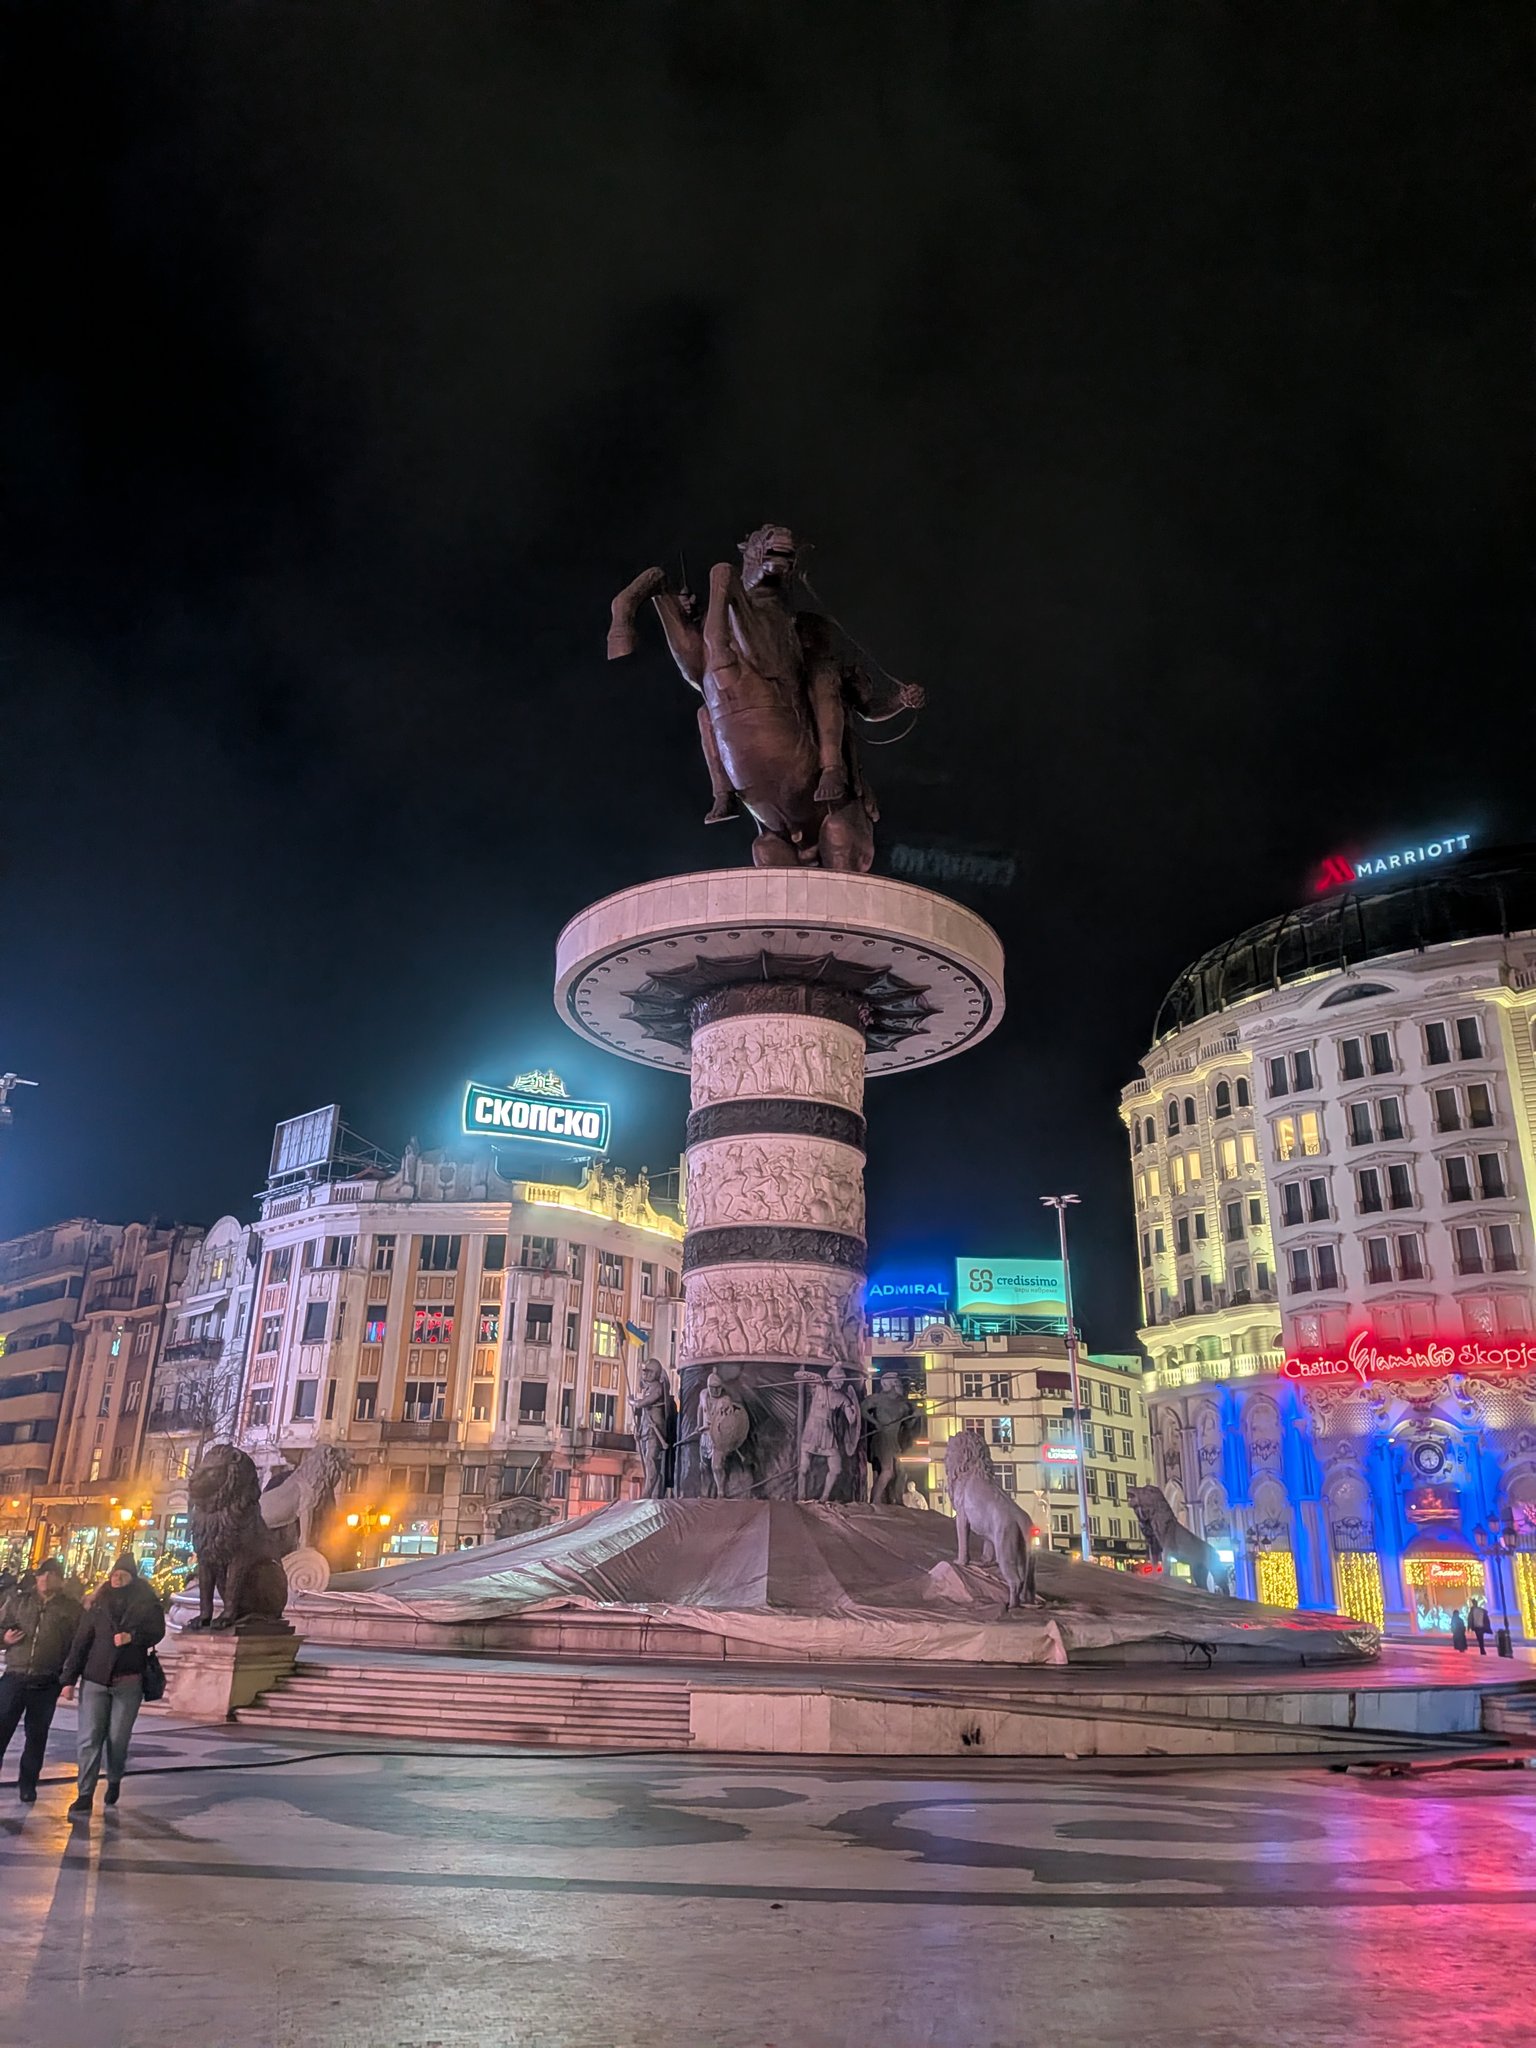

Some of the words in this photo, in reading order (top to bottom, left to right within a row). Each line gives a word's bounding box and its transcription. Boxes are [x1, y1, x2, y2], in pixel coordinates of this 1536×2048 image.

[1357, 834, 1471, 878] MARRIOTT
[475, 1096, 600, 1139] СКОПСКО
[869, 1282, 950, 1297] ADMIRAL
[996, 1274, 1058, 1287] credissimo
[1283, 1356, 1349, 1379] Casino
[1458, 1341, 1536, 1371] Skopje
